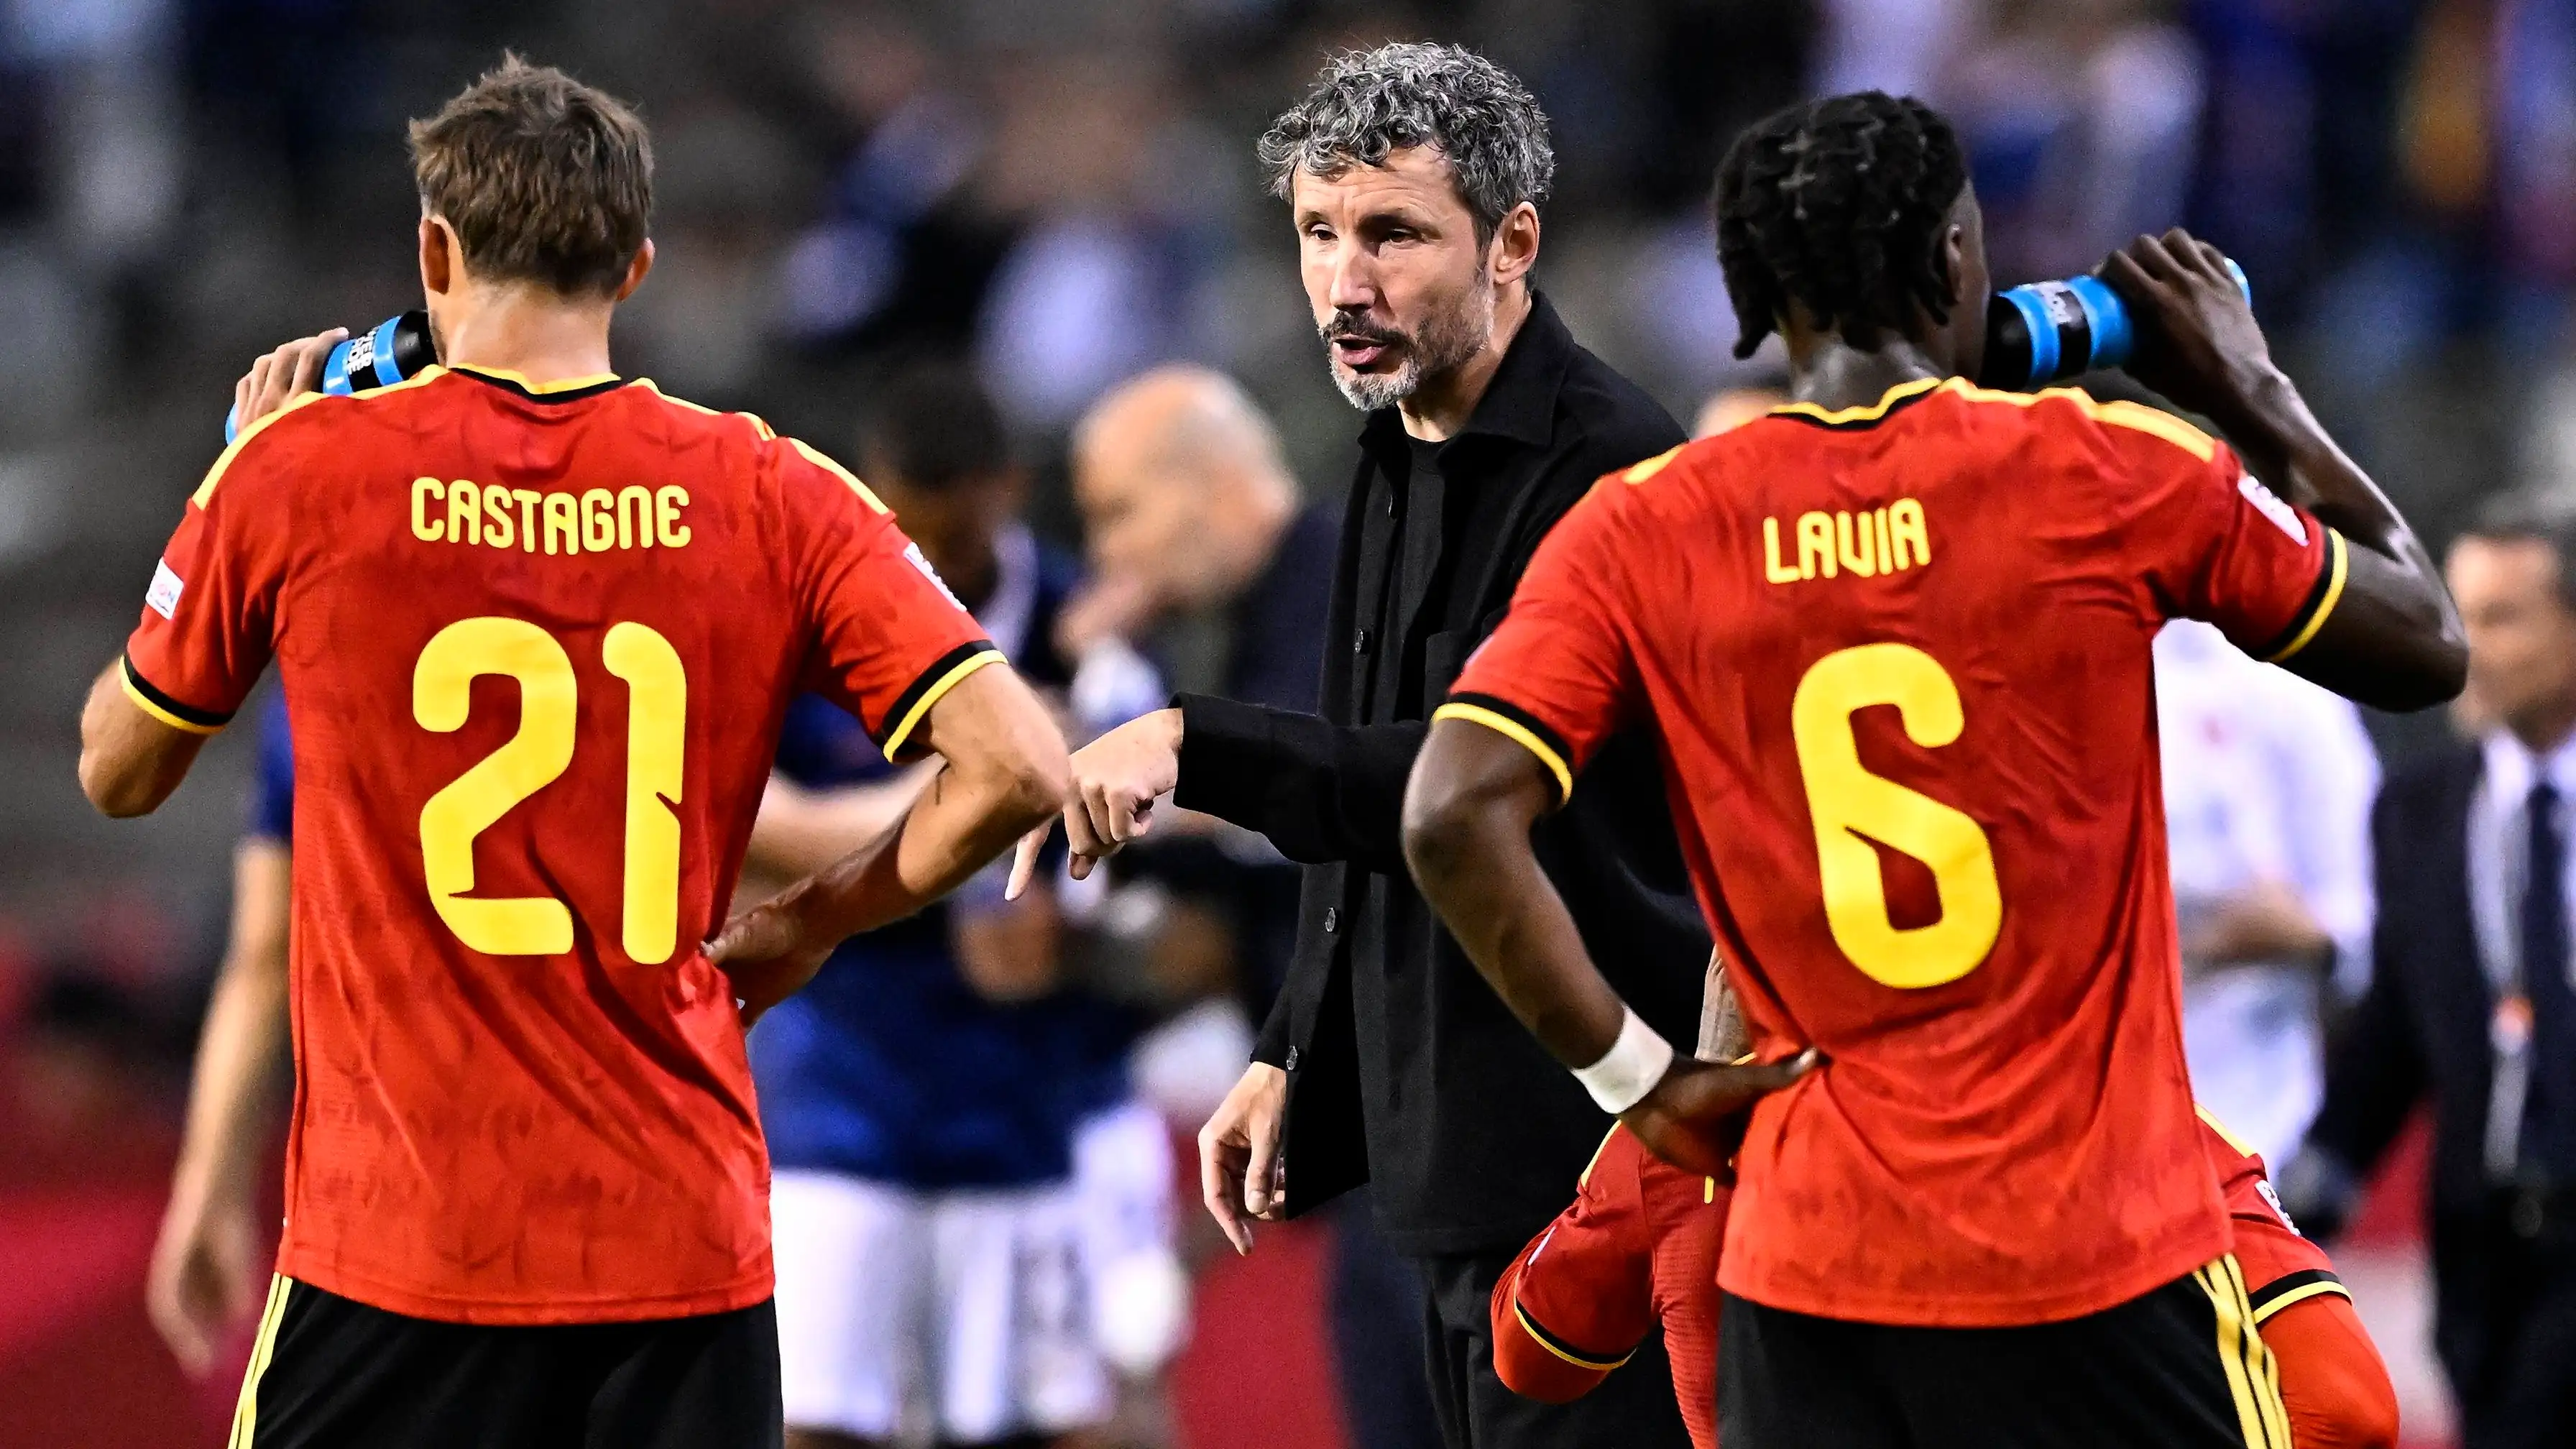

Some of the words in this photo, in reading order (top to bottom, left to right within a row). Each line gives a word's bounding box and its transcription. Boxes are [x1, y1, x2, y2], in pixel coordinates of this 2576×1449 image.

[411, 476, 691, 556] CASTAGNE
[1762, 497, 1931, 584] LAVIA
[413, 616, 687, 965] 21
[1792, 643, 2003, 989] 6
